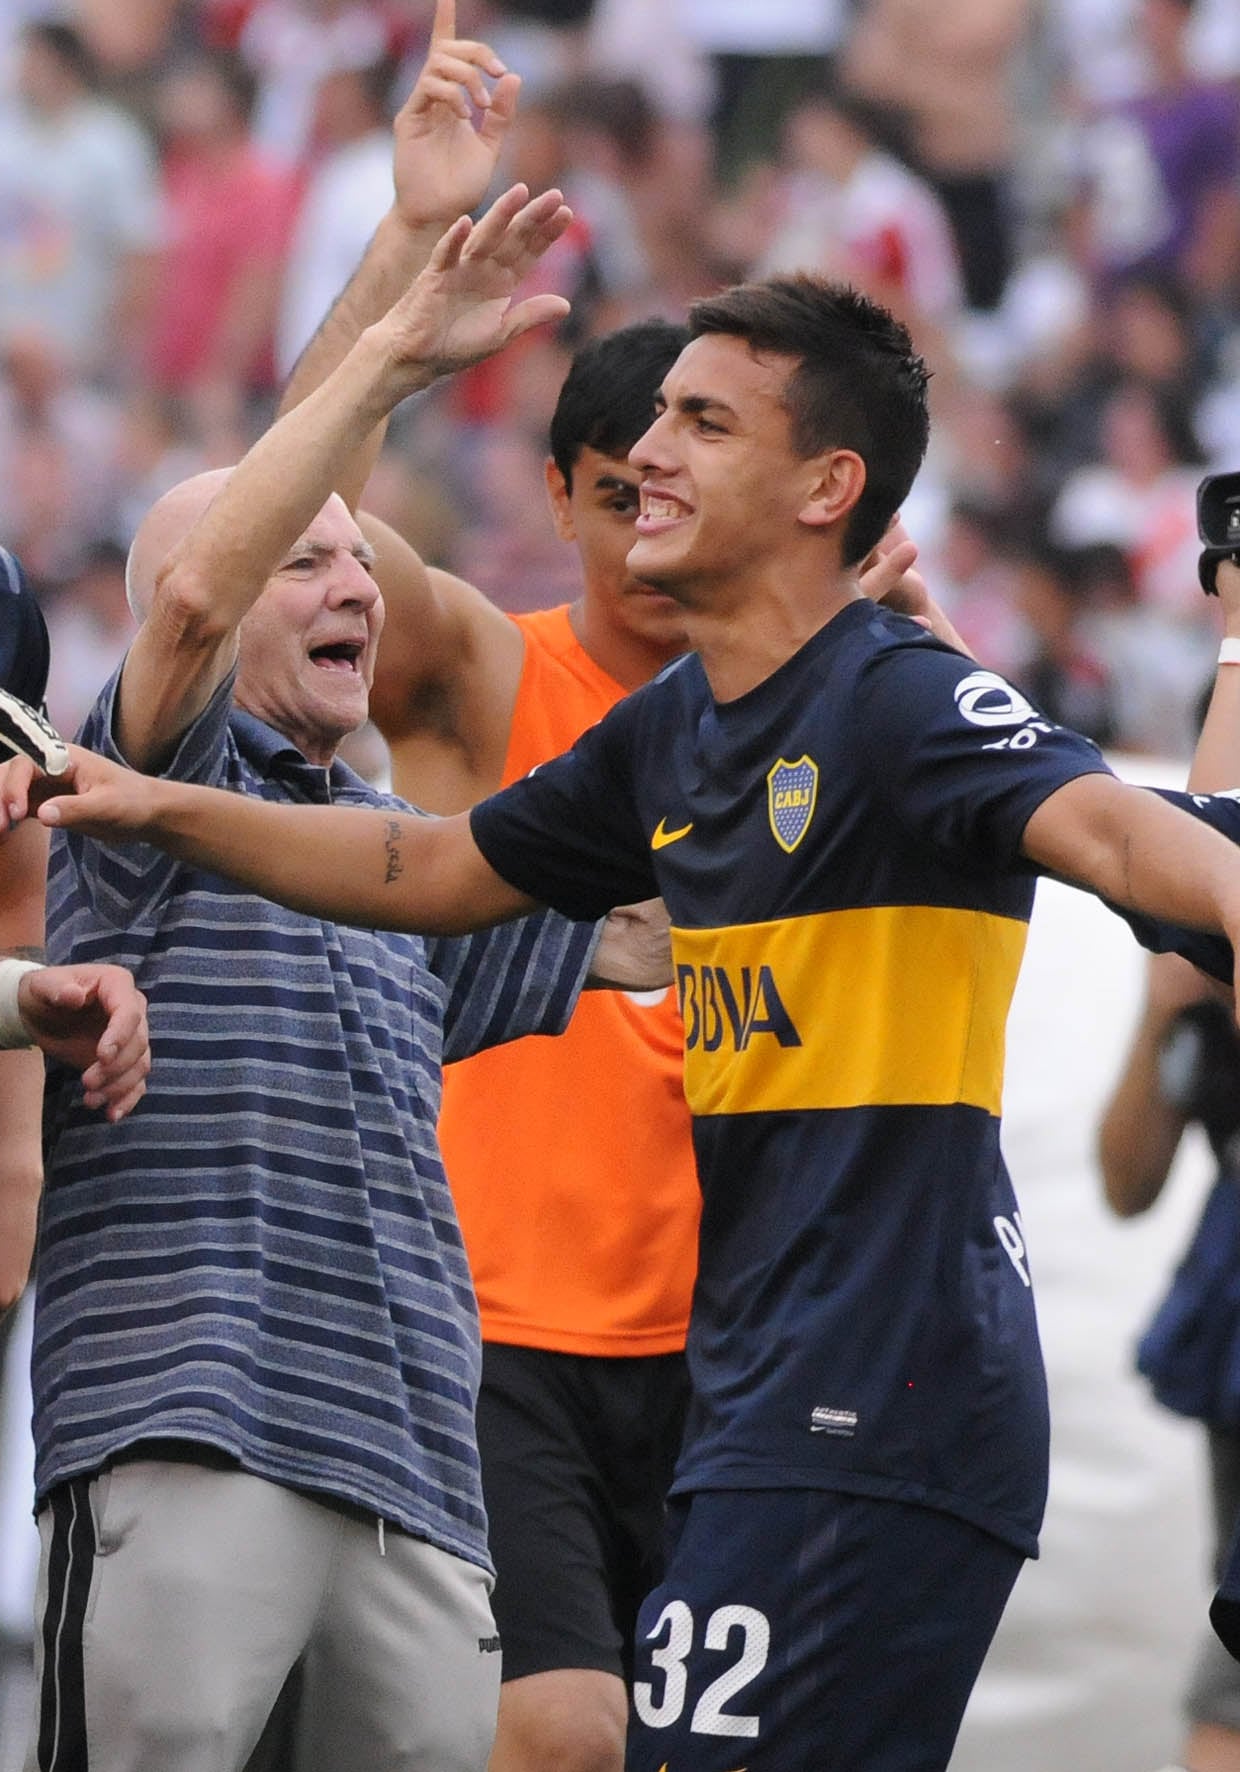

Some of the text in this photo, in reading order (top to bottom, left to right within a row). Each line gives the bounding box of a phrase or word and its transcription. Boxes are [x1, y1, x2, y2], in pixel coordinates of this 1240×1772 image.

[774, 788, 809, 809] CABJ
[676, 964, 803, 1052] BBVA
[633, 1600, 770, 1738] 32
